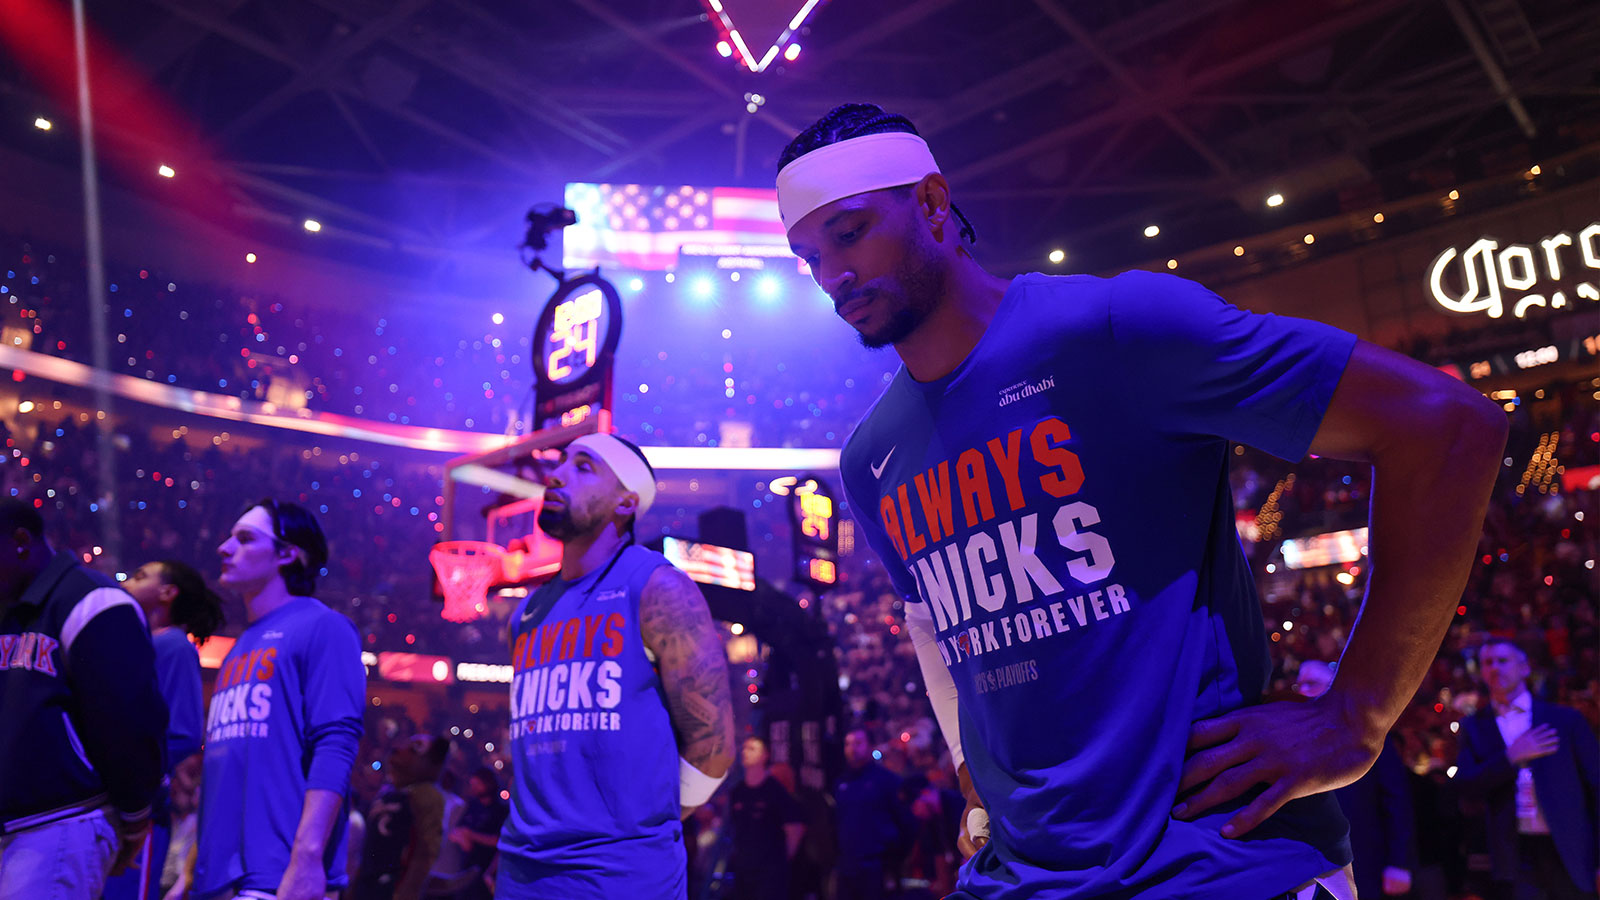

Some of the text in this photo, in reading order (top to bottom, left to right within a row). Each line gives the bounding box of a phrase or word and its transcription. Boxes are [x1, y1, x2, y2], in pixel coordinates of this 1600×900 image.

[999, 375, 1055, 407] abu dhabi
[880, 417, 1086, 561] ALWAYS
[909, 501, 1116, 635] NICKS
[512, 612, 625, 672] ALWAYS
[1000, 584, 1131, 648] FOREVER
[510, 660, 622, 720] KNICKS
[995, 659, 1039, 689] PLAYOFFS
[554, 711, 621, 732] FOREVER
